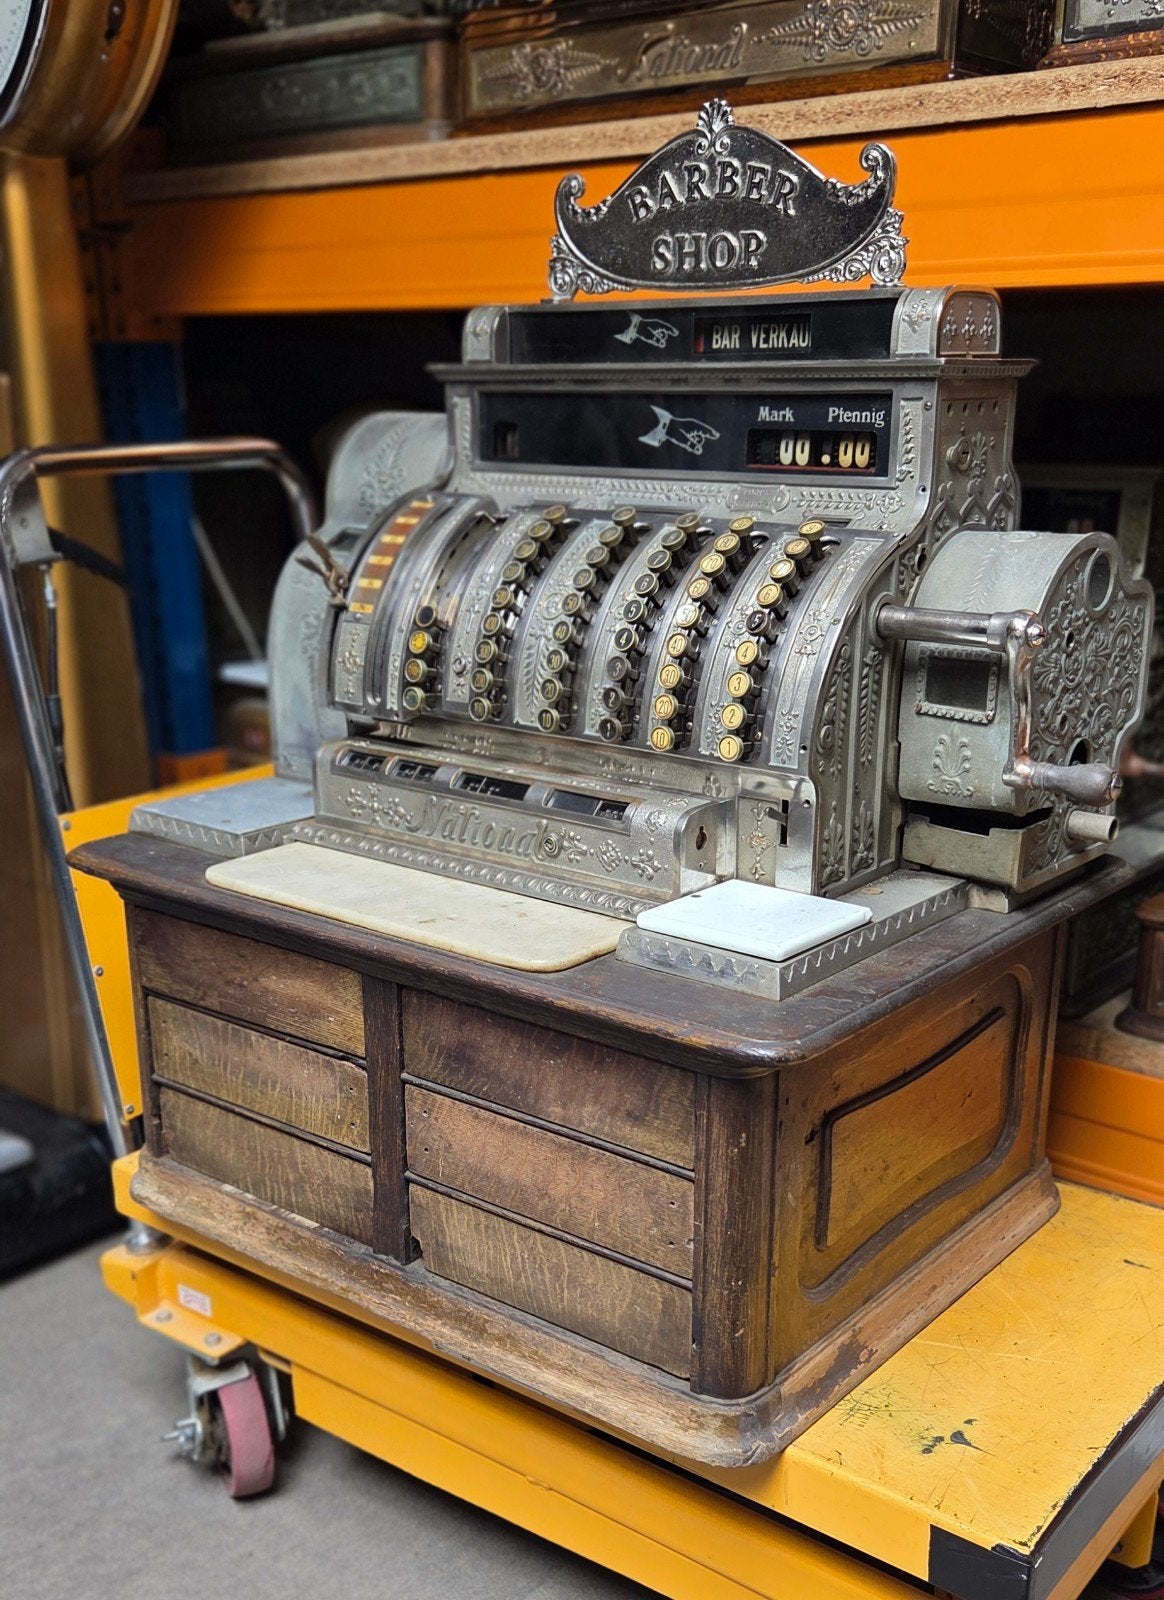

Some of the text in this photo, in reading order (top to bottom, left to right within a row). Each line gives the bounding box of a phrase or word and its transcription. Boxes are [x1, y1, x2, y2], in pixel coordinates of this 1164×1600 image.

[625, 158, 799, 223] BARBER
[652, 230, 767, 274] SHOP
[712, 323, 812, 349] BAR VERKAU
[757, 406, 885, 428] Mark Pfennig
[641, 577, 650, 591] 6
[692, 581, 706, 596] 60
[764, 588, 773, 601] 6
[628, 603, 638, 618] 5
[751, 614, 762, 628] 5
[619, 631, 628, 646] 4
[671, 637, 683, 652] 40
[741, 646, 749, 659] 4
[549, 654, 561, 668] 30
[613, 662, 622, 676] 3
[663, 669, 676, 684] 30
[543, 682, 555, 698] 20
[733, 676, 742, 692] 3
[608, 691, 616, 707] 2
[658, 700, 670, 715] 20
[542, 712, 552, 728] 10
[728, 708, 736, 724] 2
[656, 731, 666, 747] 10
[404, 795, 549, 862] National
